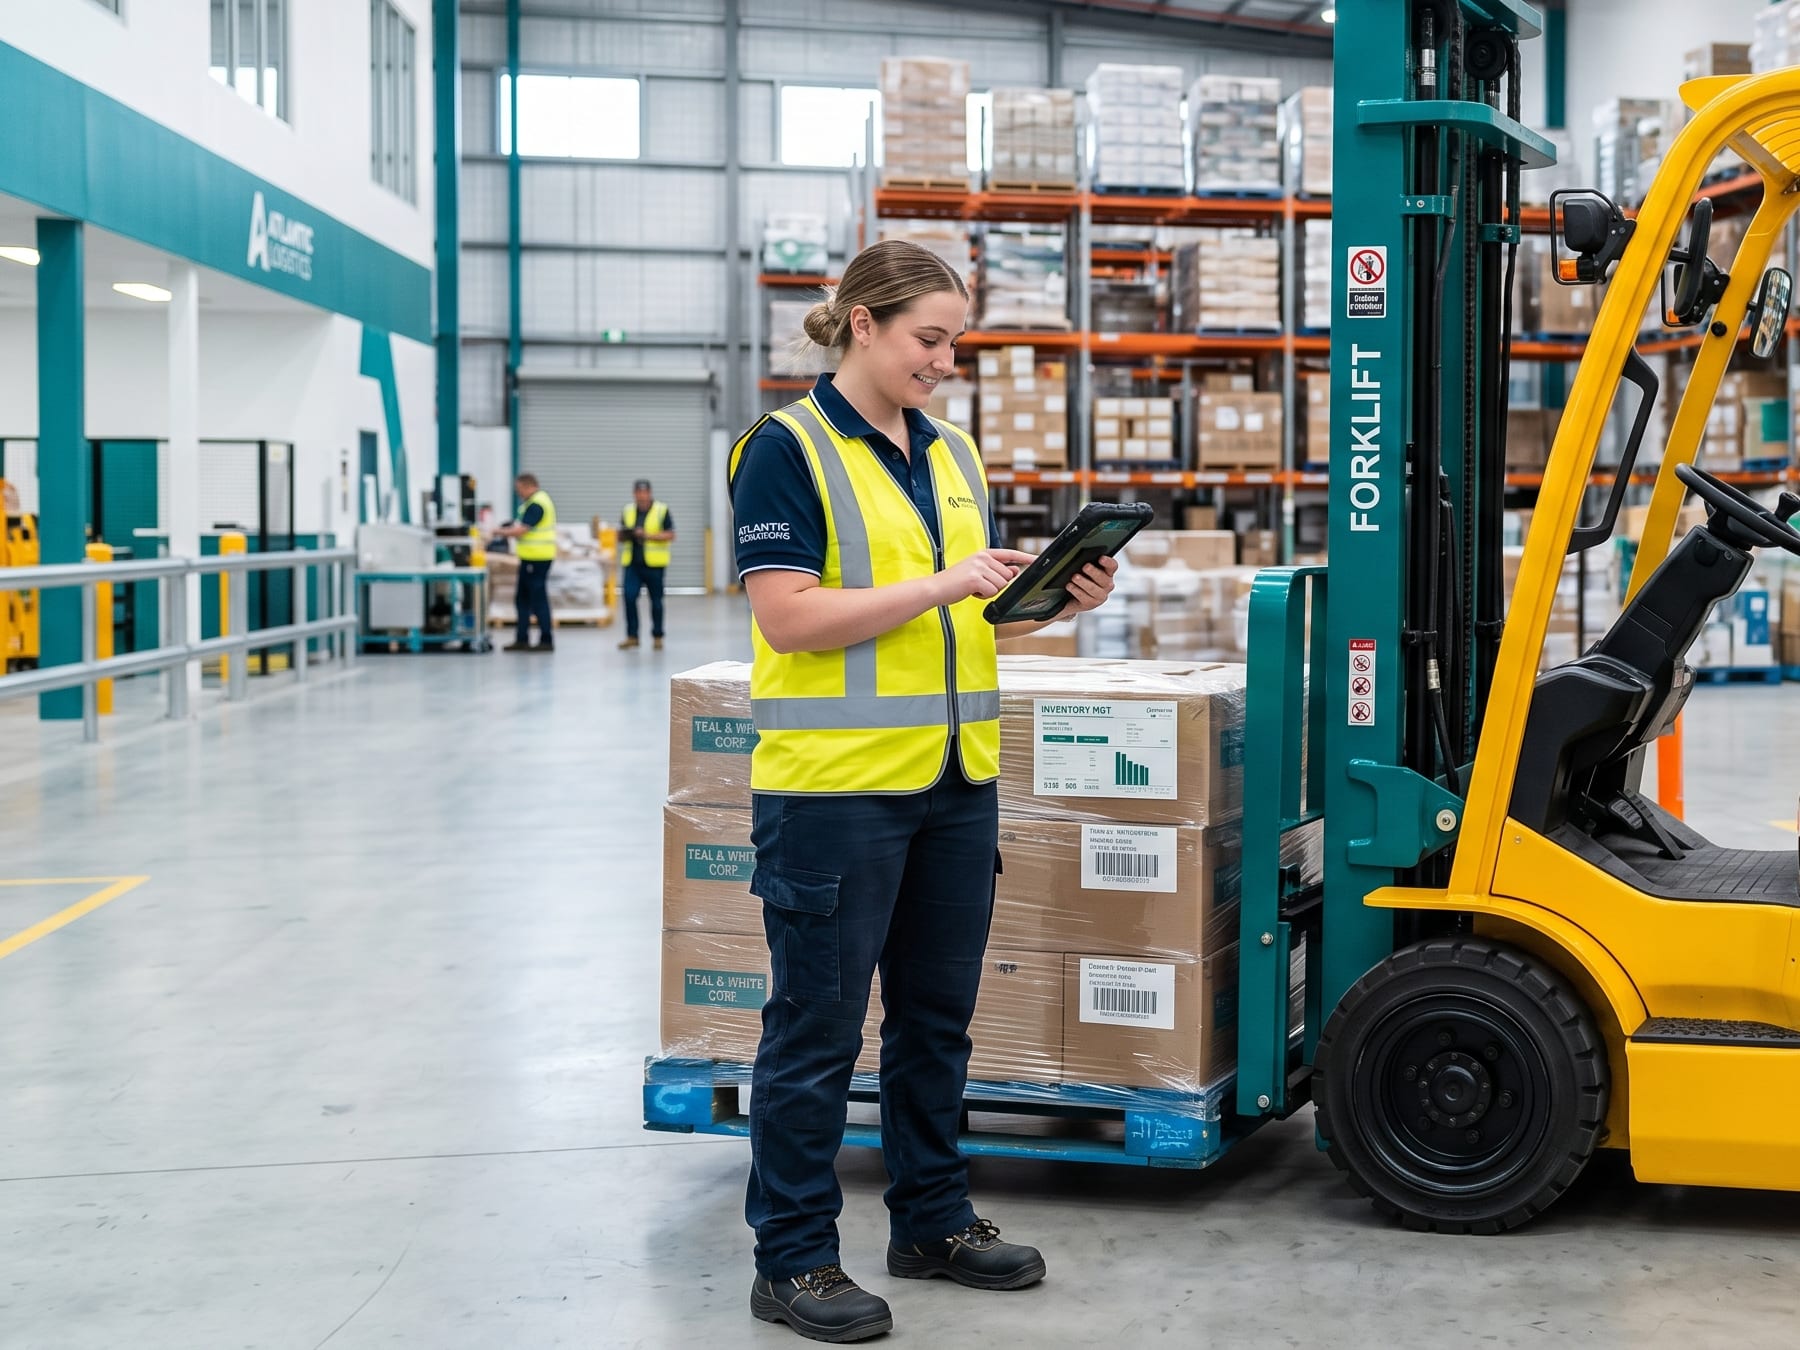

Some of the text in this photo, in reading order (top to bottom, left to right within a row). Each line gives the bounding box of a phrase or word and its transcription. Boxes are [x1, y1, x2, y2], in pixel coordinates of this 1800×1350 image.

[1350, 343, 1381, 532] FORKLIFT
[739, 522, 790, 536] ATLANTIC
[1041, 705, 1112, 715] INVENTORY MGT
[694, 720, 755, 735] TEAL & WH
[714, 736, 747, 749] CORP
[687, 848, 757, 863] TEAL & WHIT
[686, 973, 764, 990] TEAL & WHITE
